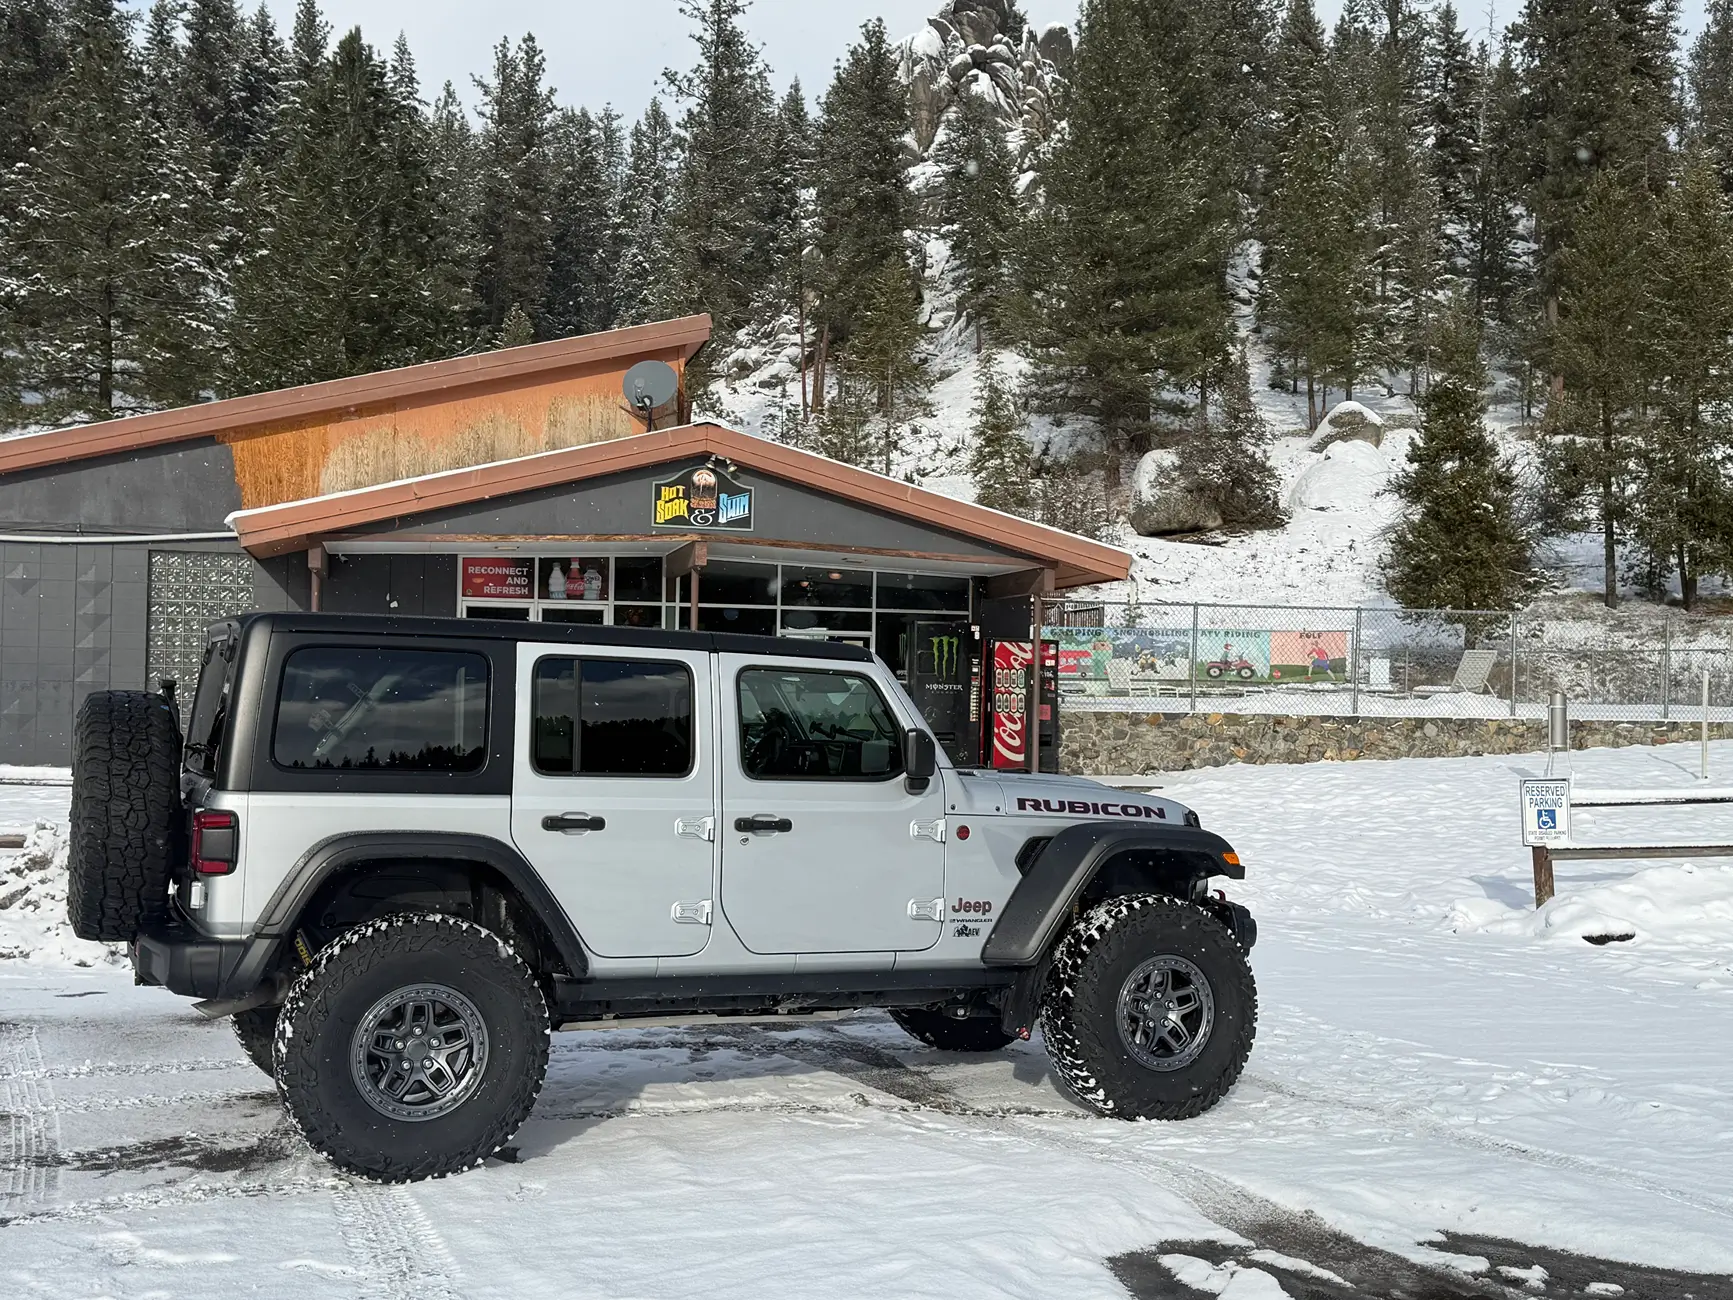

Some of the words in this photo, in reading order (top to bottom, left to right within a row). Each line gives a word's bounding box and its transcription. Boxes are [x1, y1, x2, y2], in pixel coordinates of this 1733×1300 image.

[660, 485, 686, 501] HOT
[656, 498, 689, 523] SOAK
[718, 492, 750, 523] SWIM
[690, 509, 715, 526] &
[468, 566, 528, 576] RECONNECT
[506, 577, 528, 585] AND
[483, 586, 528, 595] REFRESH
[1050, 627, 1104, 637] CAMPING
[1113, 629, 1189, 637] SNOWMOBILING
[1200, 630, 1220, 638] ATV
[1224, 630, 1261, 638] RIDING
[925, 683, 963, 691] MONSTER
[1525, 786, 1565, 796] RESERVED
[1529, 797, 1563, 808] PARKING
[1017, 797, 1166, 820] RUBICON
[951, 897, 992, 916] Jeep
